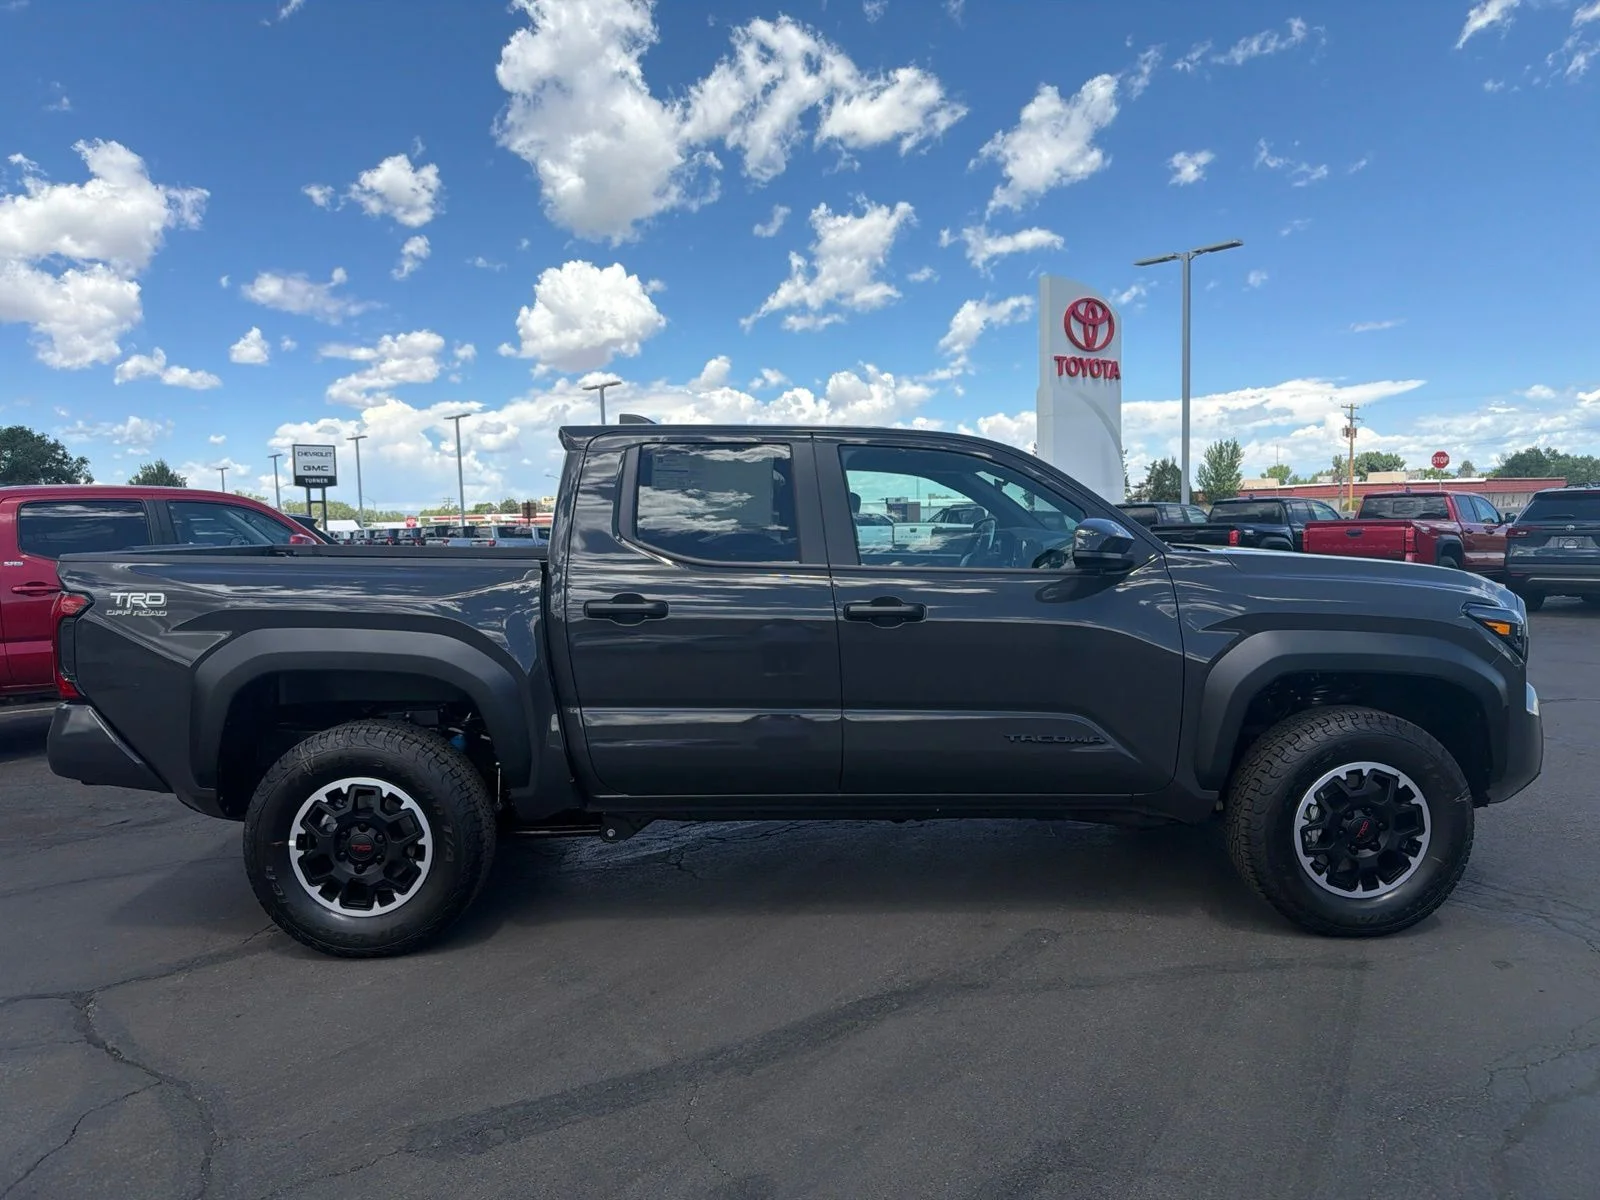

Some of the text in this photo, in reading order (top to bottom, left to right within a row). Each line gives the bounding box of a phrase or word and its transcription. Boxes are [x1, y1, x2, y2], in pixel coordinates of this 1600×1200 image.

[1053, 355, 1121, 380] TOYOTA
[1432, 456, 1449, 464] STOP
[110, 592, 167, 609] TRD
[1003, 734, 1106, 744] TACOMA
